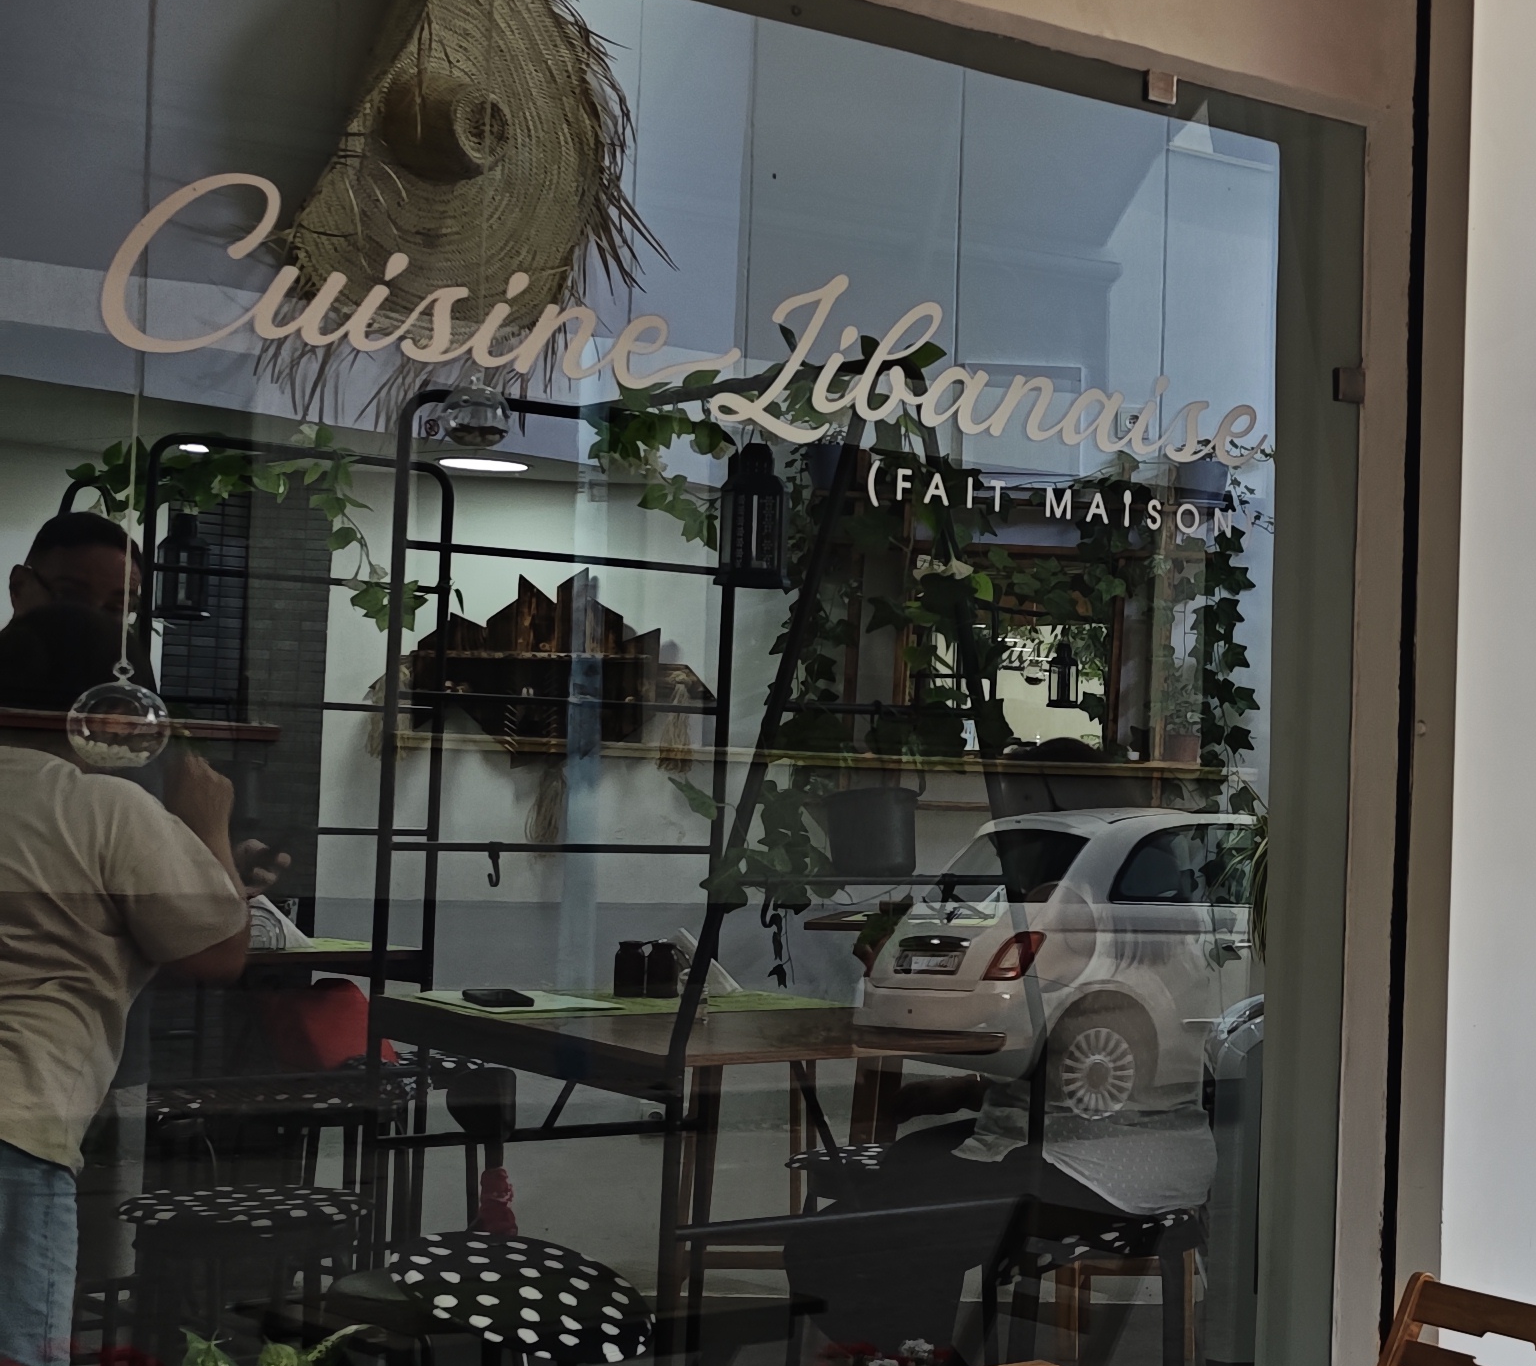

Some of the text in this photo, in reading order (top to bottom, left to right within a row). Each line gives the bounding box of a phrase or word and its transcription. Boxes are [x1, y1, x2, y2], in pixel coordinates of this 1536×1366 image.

[101, 172, 1268, 467] Cuisine Libanaise
[866, 459, 1007, 515] (FAIT
